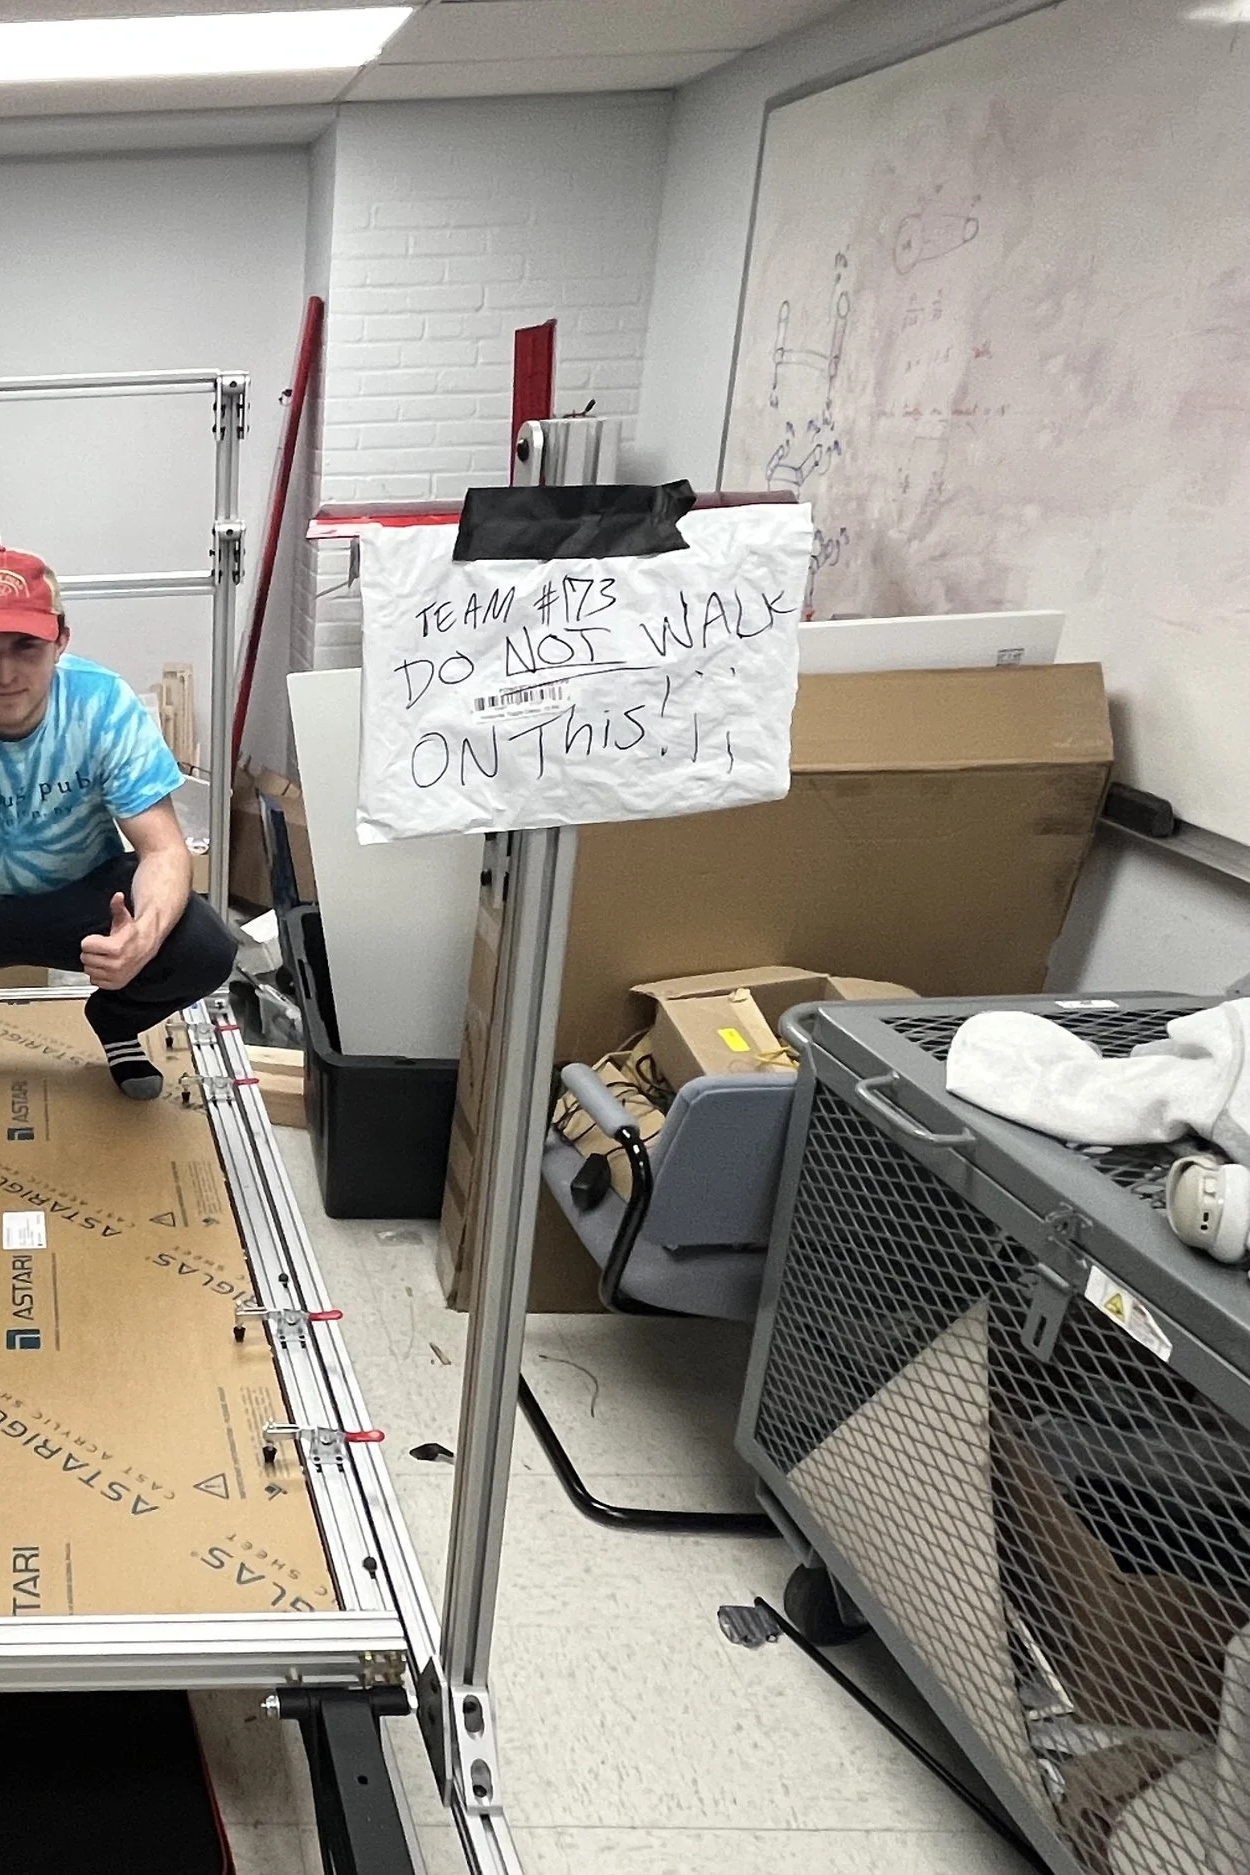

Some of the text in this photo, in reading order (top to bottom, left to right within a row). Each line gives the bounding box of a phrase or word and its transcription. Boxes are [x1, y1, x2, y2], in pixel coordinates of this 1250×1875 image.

[416, 585, 515, 638] TEAM
[393, 651, 474, 710] DO
[506, 625, 612, 676] NOT
[640, 590, 797, 657] WALK
[411, 724, 499, 788] ON
[39, 771, 92, 801] pub
[11, 1080, 30, 1123] ASTARI
[11, 1254, 35, 1321] ASTARI
[31, 1410, 114, 1461] ACRYLIC
[122, 1466, 176, 1501] CAST
[11, 1546, 41, 1616] TARI
